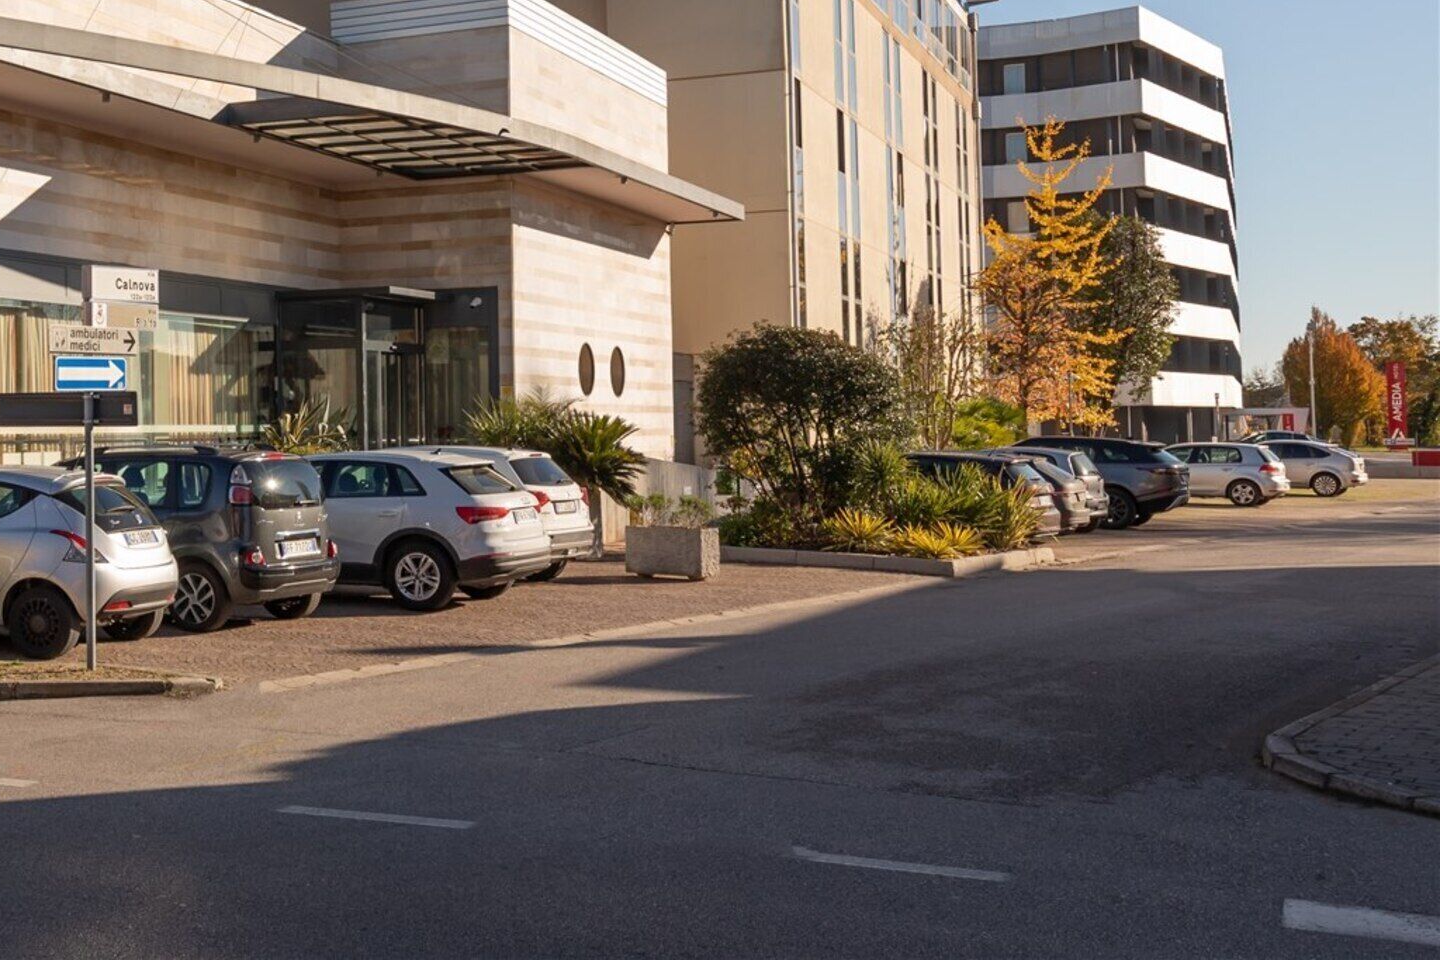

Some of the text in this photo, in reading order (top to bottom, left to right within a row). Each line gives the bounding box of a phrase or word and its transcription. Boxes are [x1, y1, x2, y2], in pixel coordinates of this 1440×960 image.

[115, 277, 156, 292] Calnova
[69, 328, 119, 340] ambulatori
[69, 341, 101, 352] medici
[1391, 381, 1403, 422] AMEDIA
